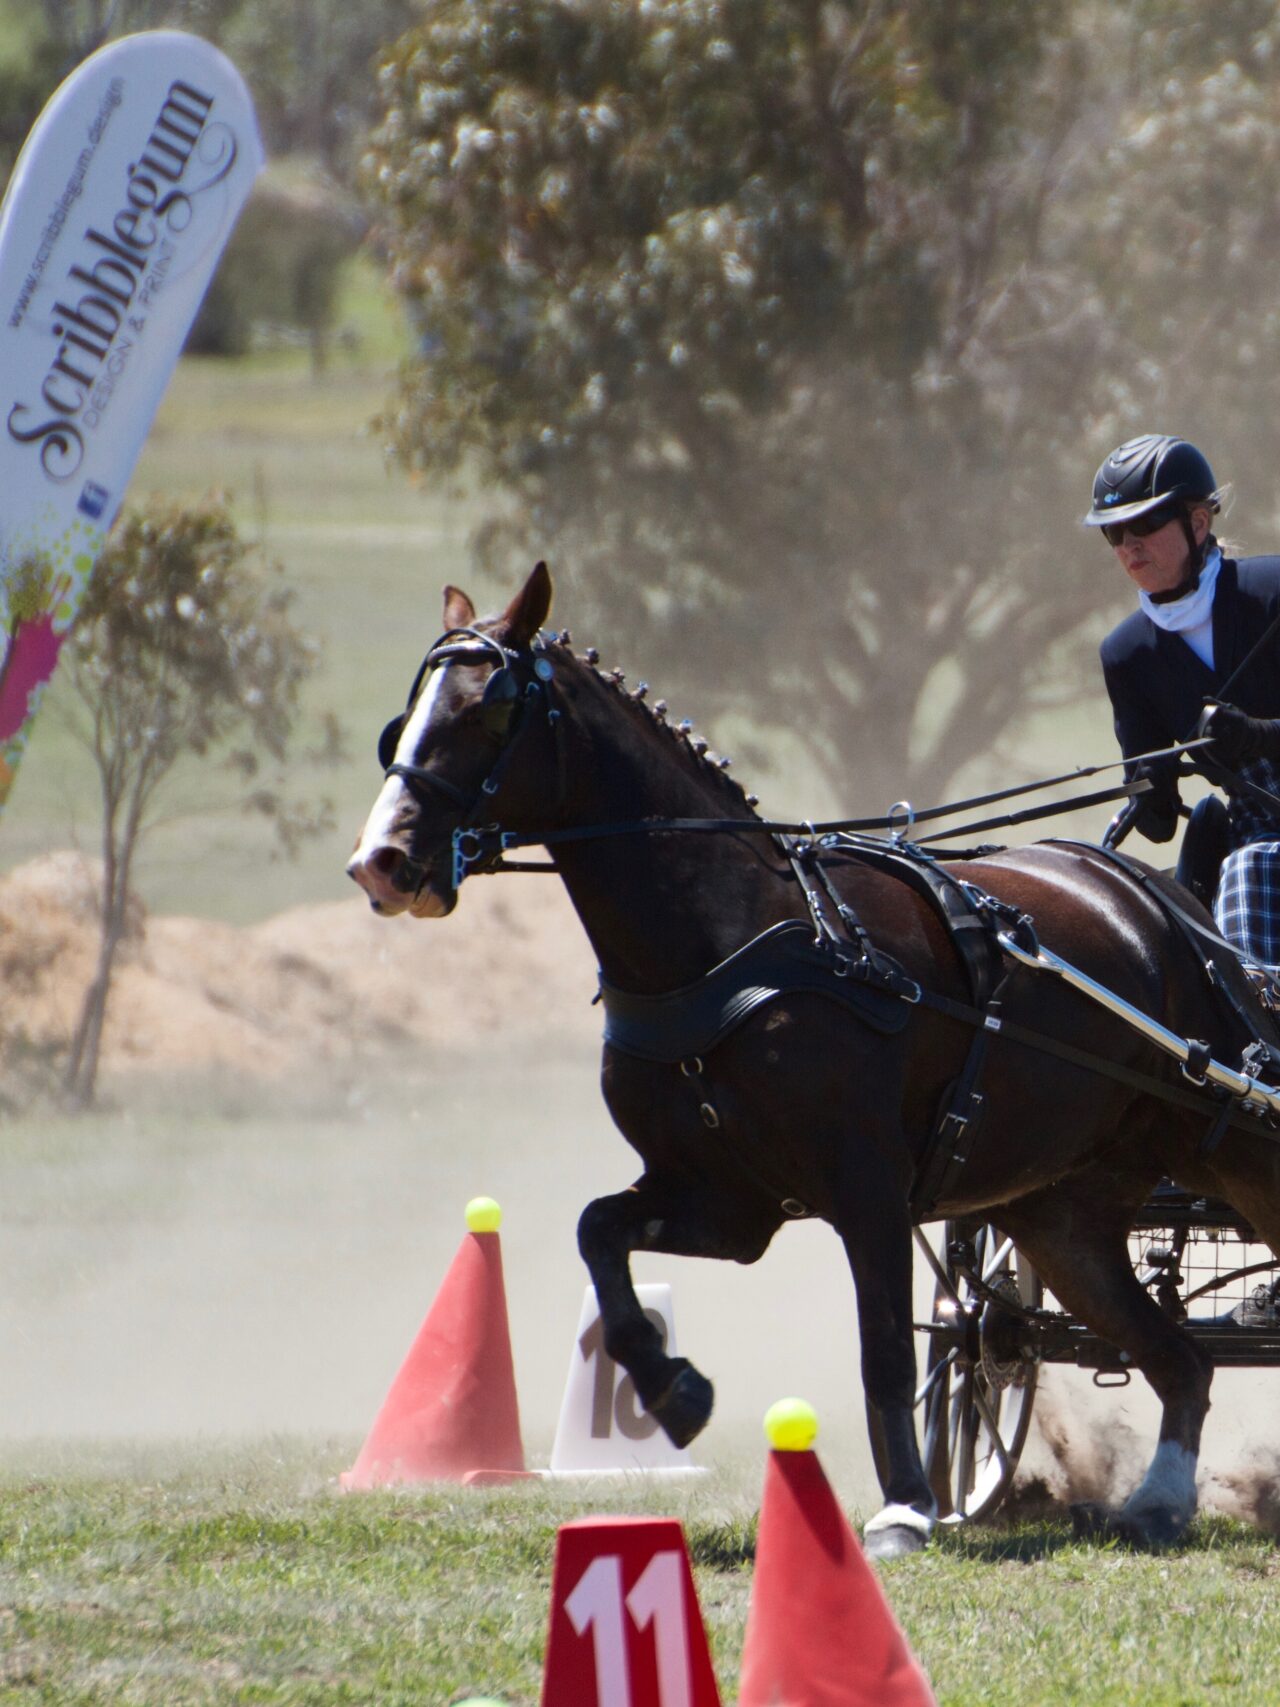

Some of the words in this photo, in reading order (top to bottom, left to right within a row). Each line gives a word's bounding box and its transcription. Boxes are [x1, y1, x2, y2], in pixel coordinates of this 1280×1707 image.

[7, 79, 237, 484] Scribblegum
[82, 337, 133, 430] DESIGN
[128, 315, 146, 333] &
[138, 238, 177, 306] PRINT
[563, 1550, 693, 1707] 11
